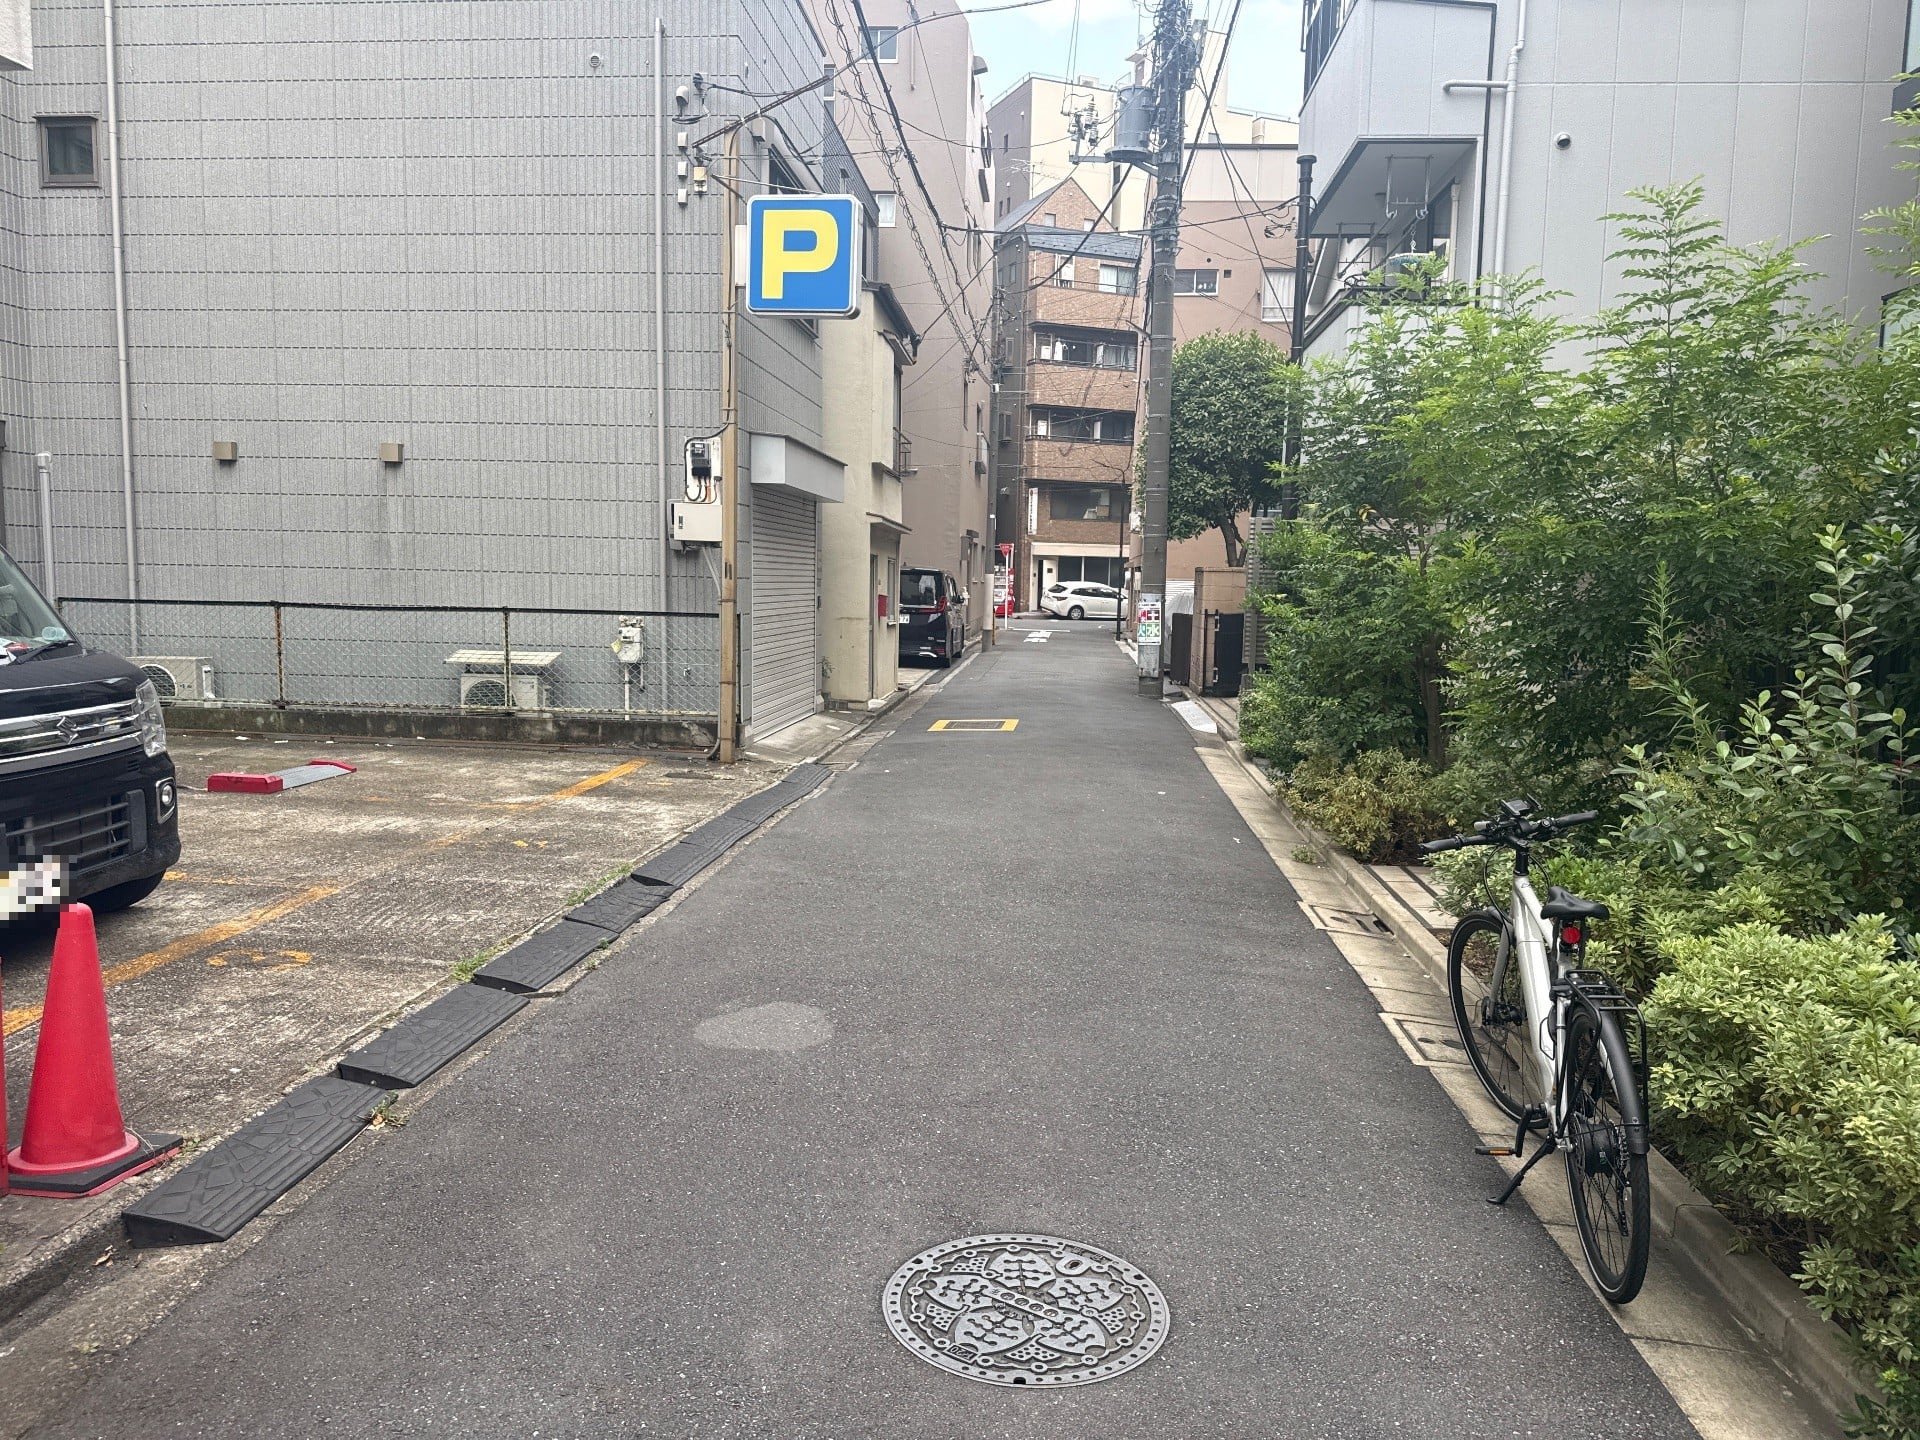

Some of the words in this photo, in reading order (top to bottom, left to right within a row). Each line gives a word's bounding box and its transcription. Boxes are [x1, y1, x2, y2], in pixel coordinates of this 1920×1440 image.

[761, 209, 839, 300] P
[1147, 611, 1160, 622] 土
[1147, 624, 1160, 636] 水
